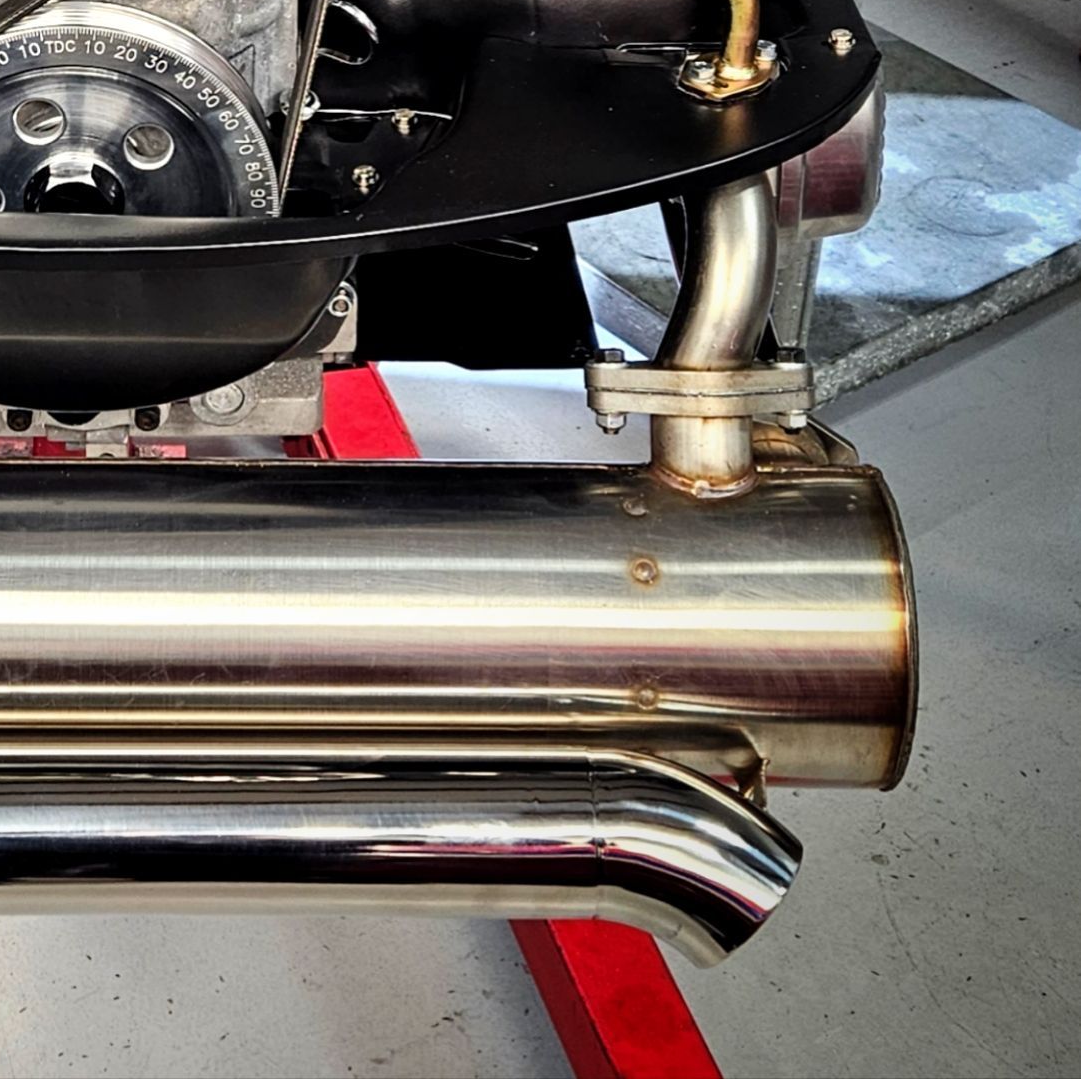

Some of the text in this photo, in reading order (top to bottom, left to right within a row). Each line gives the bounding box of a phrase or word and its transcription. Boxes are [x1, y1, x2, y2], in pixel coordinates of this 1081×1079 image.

[19, 42, 41, 59] 10
[44, 39, 76, 54] TDC
[84, 40, 106, 55] 10
[113, 45, 138, 62] 20
[144, 54, 168, 74] 30
[174, 71, 197, 90] 40
[197, 87, 220, 108] 50
[219, 110, 240, 131] 60
[234, 133, 254, 156] 70
[245, 161, 263, 182] 80
[250, 188, 266, 209] 90
